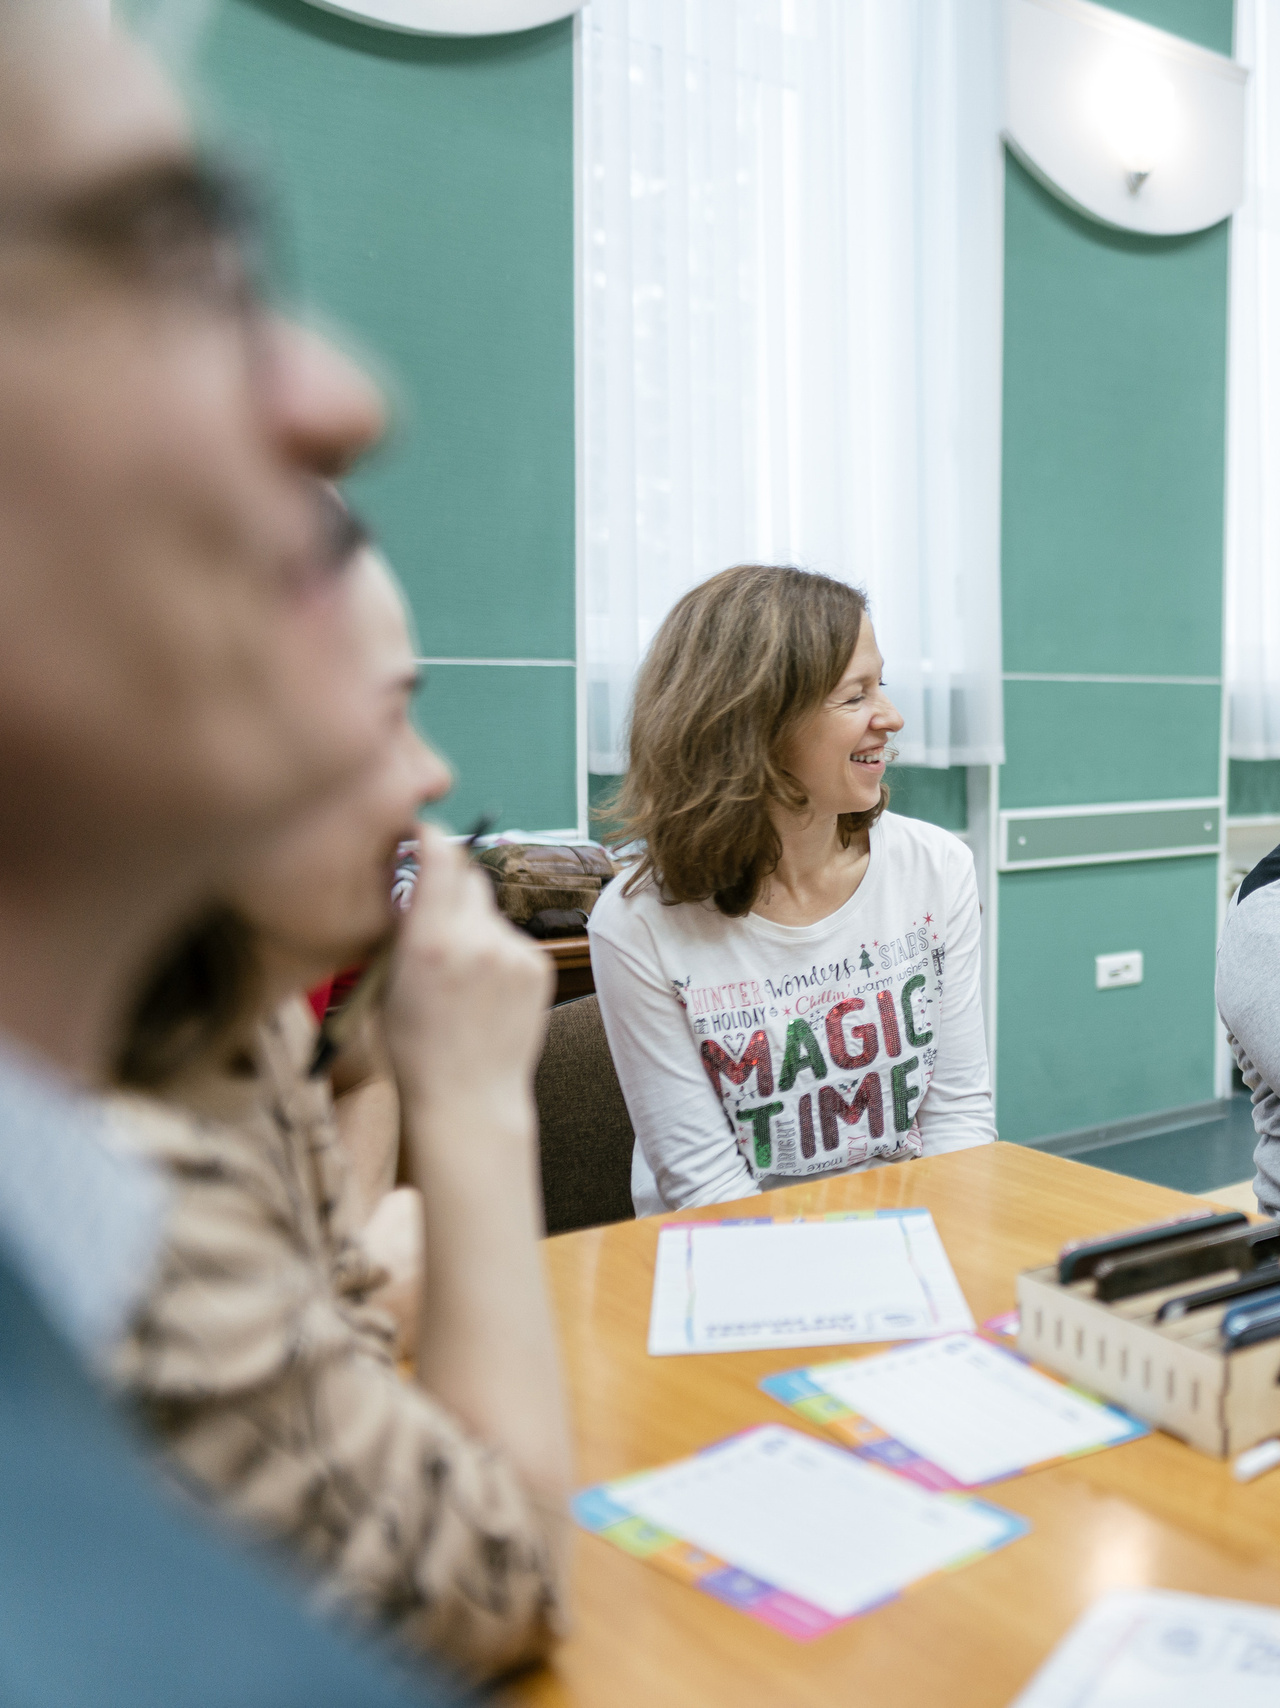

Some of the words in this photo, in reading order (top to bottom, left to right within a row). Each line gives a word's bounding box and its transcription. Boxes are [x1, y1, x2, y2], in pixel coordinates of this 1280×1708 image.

[690, 980, 765, 1016] WINTER
[765, 958, 855, 1000] Wonders
[880, 927, 930, 970] STARS
[853, 975, 893, 997] warm
[897, 957, 929, 981] wishes
[700, 973, 934, 1099] MAGIC
[711, 1006, 766, 1034] HOLIDAY
[735, 1055, 920, 1170] TIME
[776, 1118, 798, 1170] BRIGHT
